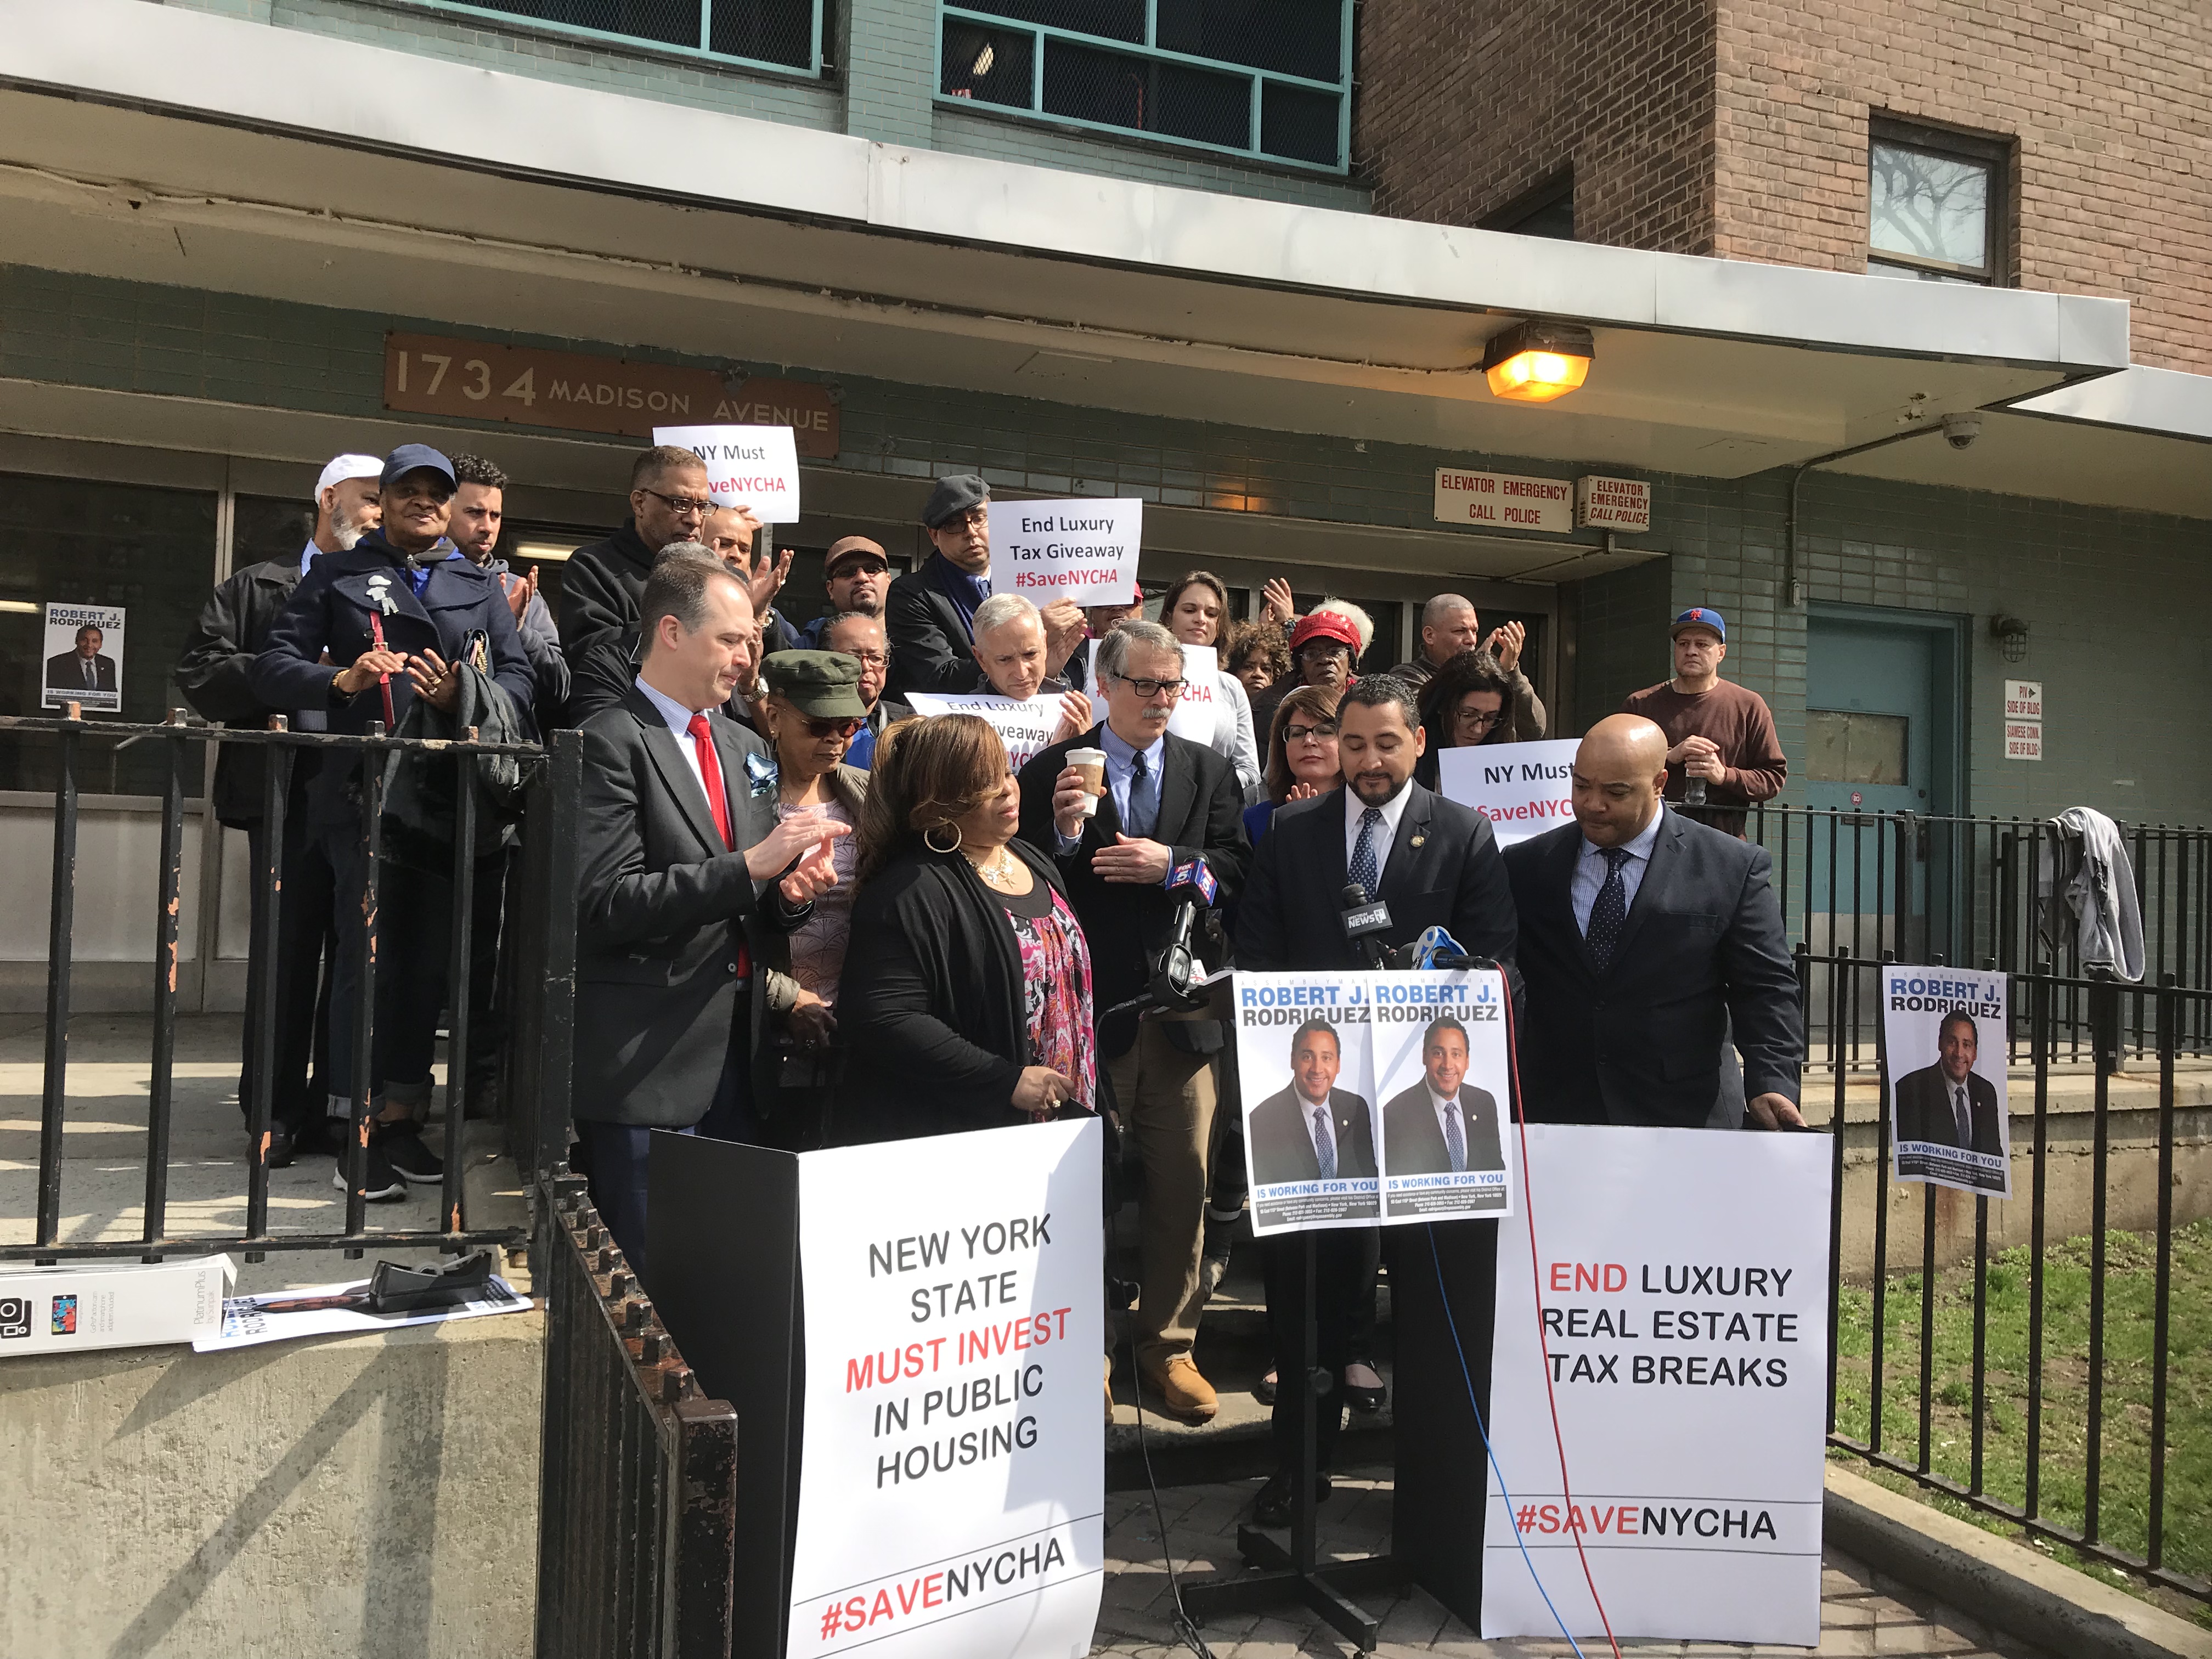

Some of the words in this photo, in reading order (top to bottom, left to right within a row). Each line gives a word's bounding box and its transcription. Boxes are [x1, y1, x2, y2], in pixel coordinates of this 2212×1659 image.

[396, 351, 537, 407] 1734
[548, 379, 691, 415] MADISON
[713, 399, 829, 432] AVENUE
[693, 445, 716, 460] NY
[724, 445, 765, 460] Must
[708, 477, 786, 493] veNYCHA
[1442, 474, 1494, 493] ELEVATOR
[1503, 481, 1567, 500] EMERGENCY
[1597, 480, 1643, 496] ELEVATOR
[1591, 493, 1648, 510] EMERGENCY
[1469, 503, 1496, 520] CALL
[1504, 507, 1541, 524] POLICE
[1590, 507, 1613, 521] CALL
[1615, 510, 1647, 524] POLICE
[1022, 516, 1053, 532] End
[1060, 517, 1114, 533] Luxury
[1010, 545, 1041, 560] Tax
[1047, 543, 1124, 560] Giveaway
[1016, 569, 1118, 587] #SaveNYCHA
[50, 608, 105, 620] ROBERT
[50, 617, 121, 629] RODRIGUEZ
[2019, 686, 2028, 698] PIV
[947, 702, 982, 710] End
[985, 702, 1043, 717] Luxury
[2007, 700, 2018, 713] SIDE
[2019, 701, 2026, 714] OF
[2027, 702, 2040, 715] BLDG
[992, 721, 1053, 746] iveaway
[2007, 725, 2025, 738] SIAMESE
[2009, 742, 2018, 754] SIDE
[2020, 742, 2025, 755] OF
[2027, 743, 2038, 755] BLDG
[1485, 765, 1514, 784] NY
[1522, 763, 1574, 781] Must
[1472, 799, 1572, 821] SaveNYC
[1177, 864, 1192, 872] FOX
[1177, 870, 1189, 882] 5
[1348, 914, 1375, 928] NEWS
[1242, 986, 1340, 1007] ROBERT
[1349, 986, 1369, 1005] J.
[1375, 985, 1469, 1003] ROBERT
[1477, 985, 1497, 1002] J.
[1891, 978, 1978, 999] ROBERT
[1984, 985, 2000, 1002] J.
[1244, 1006, 1370, 1026] RODRIGUEZ
[1377, 1005, 1498, 1022] RODRIGUEZ
[1891, 997, 2001, 1019] RODRIGUEZ
[1912, 1144, 1958, 1159] WORKING
[1961, 1152, 1978, 1163] FOR
[1981, 1156, 2001, 1167] YOU
[1257, 1189, 1266, 1198] IS
[1269, 1184, 1318, 1197] WORKING
[1323, 1182, 1347, 1193] FOR
[1351, 1181, 1378, 1191] YOU
[1389, 1180, 1398, 1189] IS
[1402, 1176, 1451, 1188] WORKING
[1454, 1175, 1476, 1185] FOR
[1479, 1174, 1503, 1183] YOU
[869, 1230, 949, 1278] NEW
[961, 1213, 1051, 1259] YORK
[1550, 1263, 1627, 1292] END
[1642, 1265, 1792, 1297] LUXURY
[194, 1271, 206, 1324] PlatinumPlus
[207, 1290, 215, 1314] Sunpak
[911, 1270, 1017, 1323] STATE
[1542, 1308, 1639, 1338] REAL
[1653, 1311, 1798, 1342] ESTATE
[846, 1337, 946, 1393] MUST
[958, 1307, 1071, 1365] INVEST
[1548, 1353, 1618, 1384] TAX
[1633, 1355, 1787, 1387] BREAKS
[874, 1397, 909, 1437] IN
[923, 1364, 1043, 1425] PUBLIC
[877, 1415, 1037, 1488] HOUSING
[1517, 1504, 1776, 1540] #SAVENYCHA
[821, 1537, 1065, 1640] #SAVENYCHA
